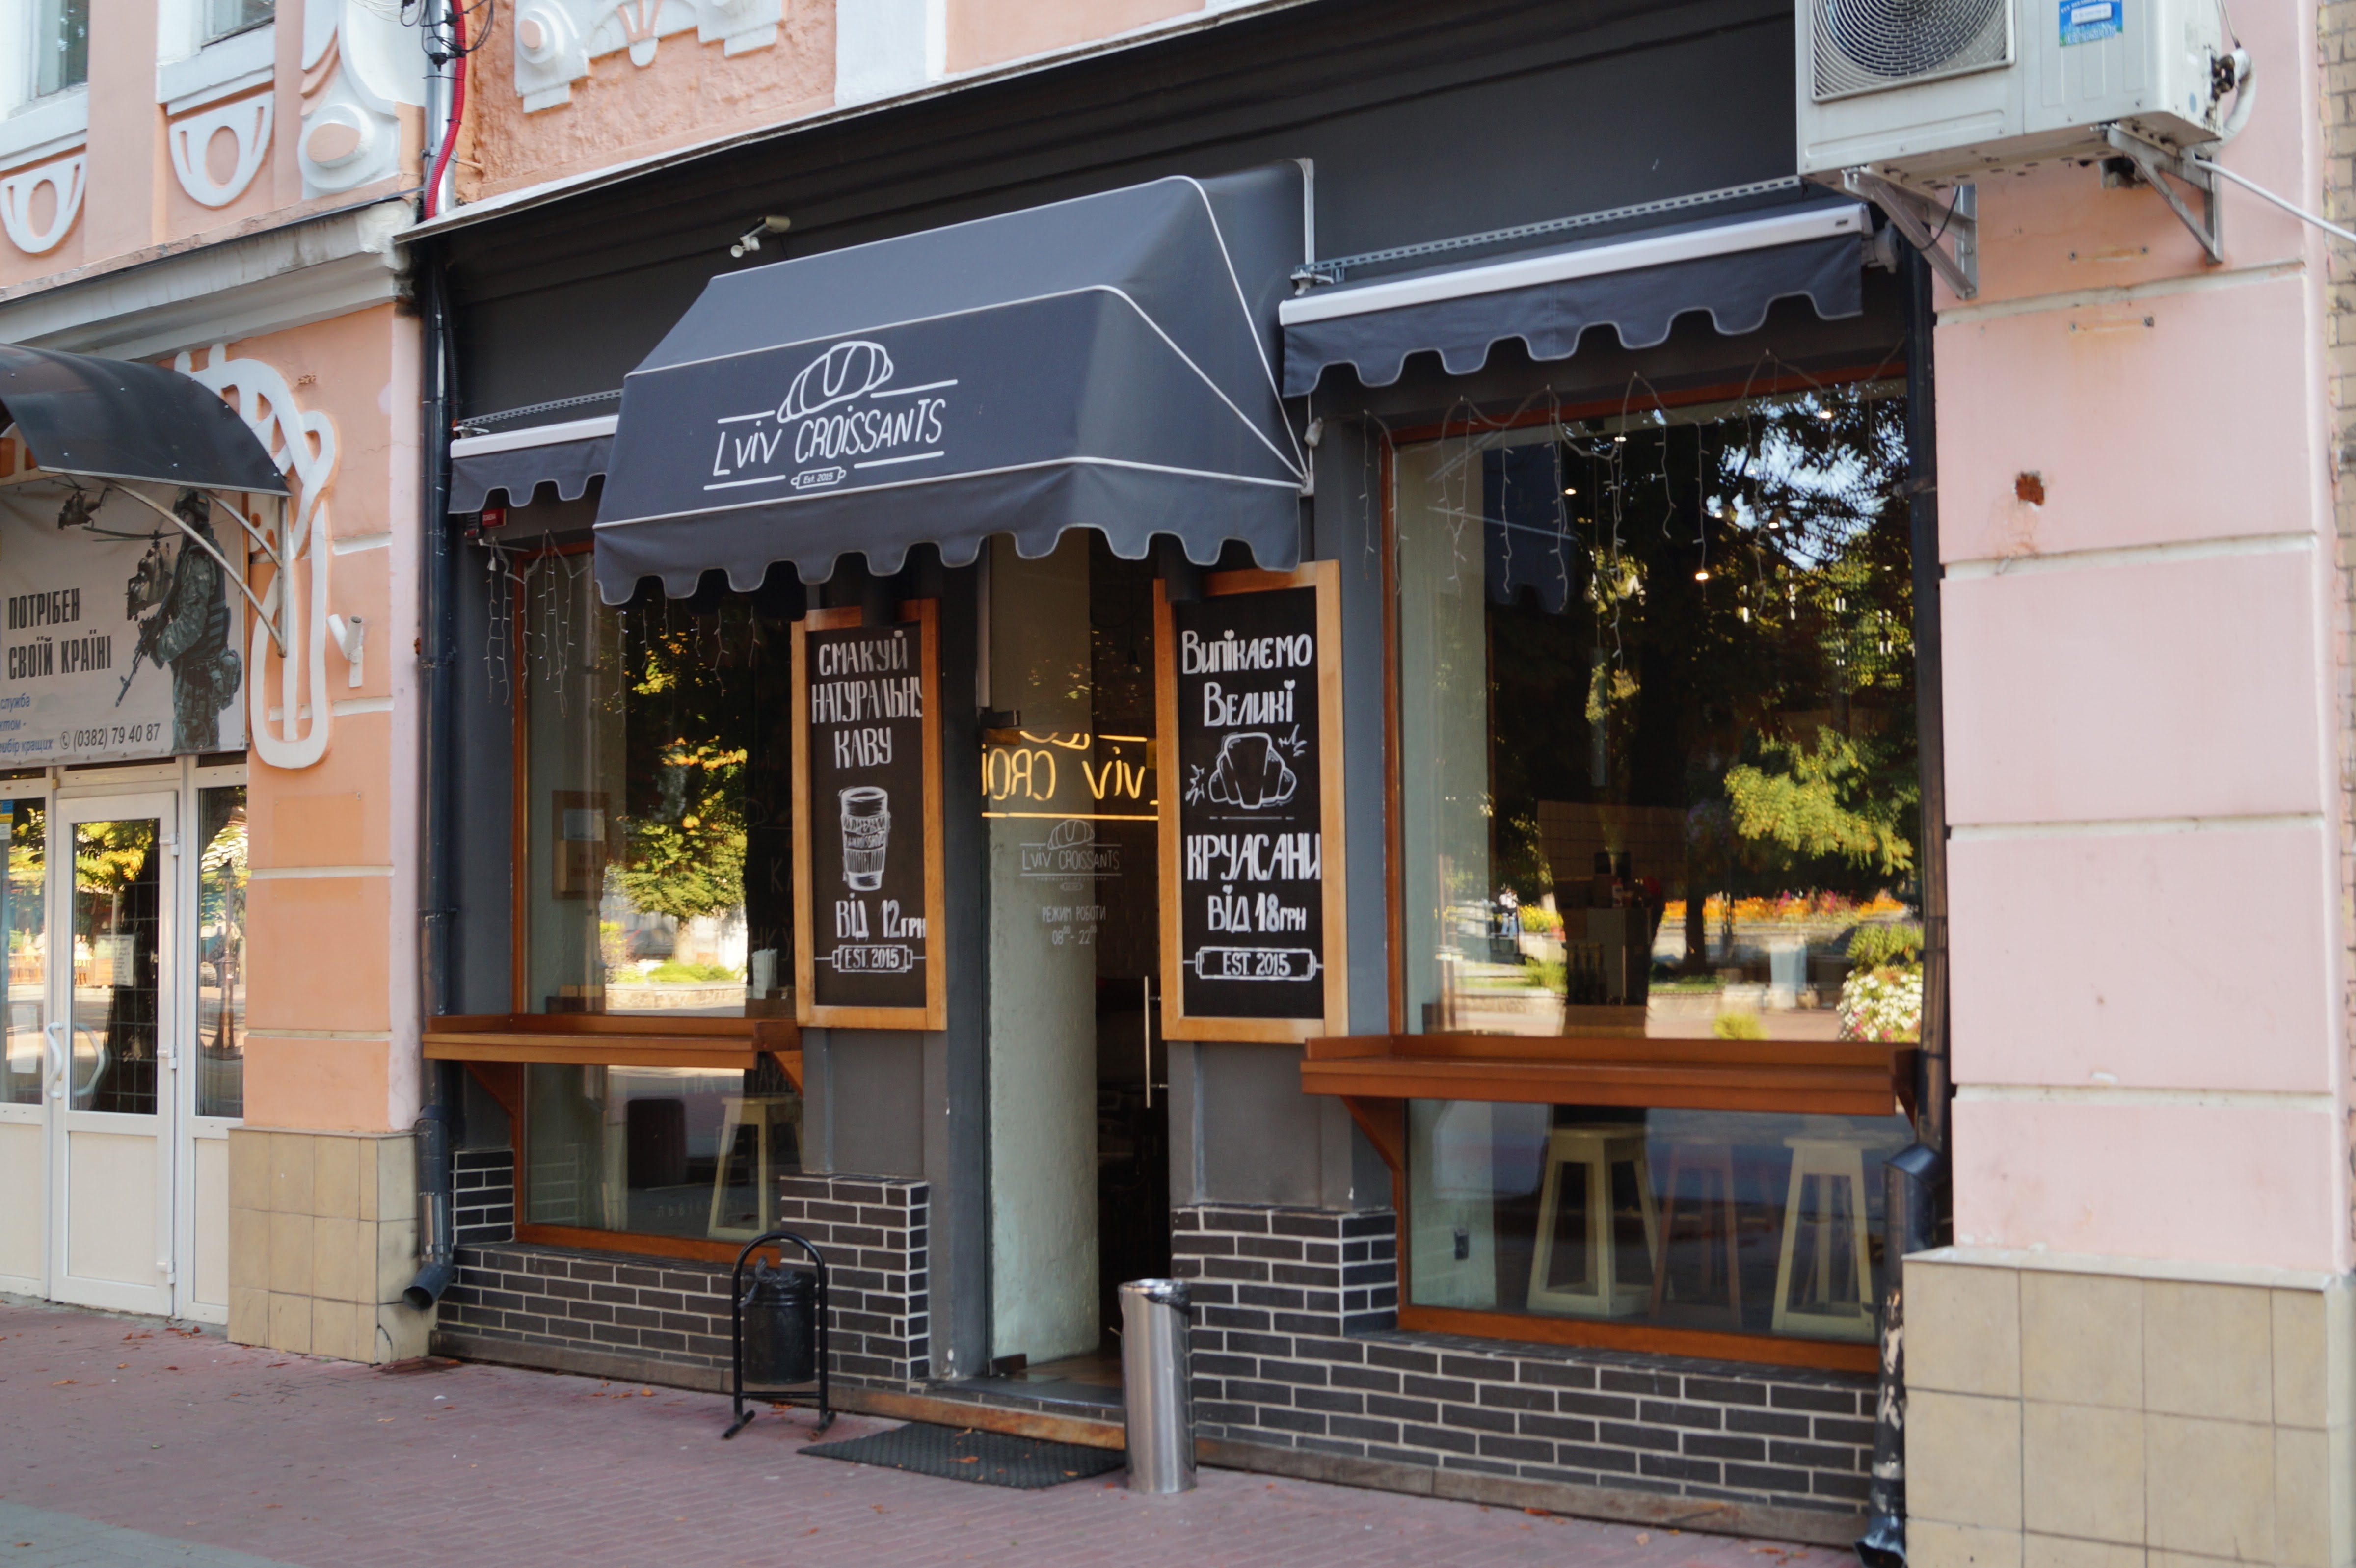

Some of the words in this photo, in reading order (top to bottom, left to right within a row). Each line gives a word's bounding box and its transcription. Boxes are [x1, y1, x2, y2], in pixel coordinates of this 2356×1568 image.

[817, 472, 833, 482] 2015
[9, 588, 80, 630] ПОТРІБЕН
[9, 636, 53, 680] СВОЇЙ
[61, 629, 111, 674] КРАЇНІ
[819, 630, 908, 676] СМАКУЙ
[1, 692, 30, 713] служба
[22, 739, 54, 755] кращих
[74, 727, 107, 752] (0382)
[112, 727, 125, 744] 79
[129, 725, 142, 743] 40
[146, 723, 161, 741] 87
[834, 727, 892, 769] КАВУ
[1187, 833, 1321, 880] КРУАСАНИ
[1042, 906, 1071, 923] РЕЖИМ
[1076, 905, 1106, 921] РОБОТИ
[845, 948, 869, 968] EST.
[871, 948, 899, 968] 2015
[1223, 952, 1250, 976] EST.
[1256, 953, 1291, 976] 2015
